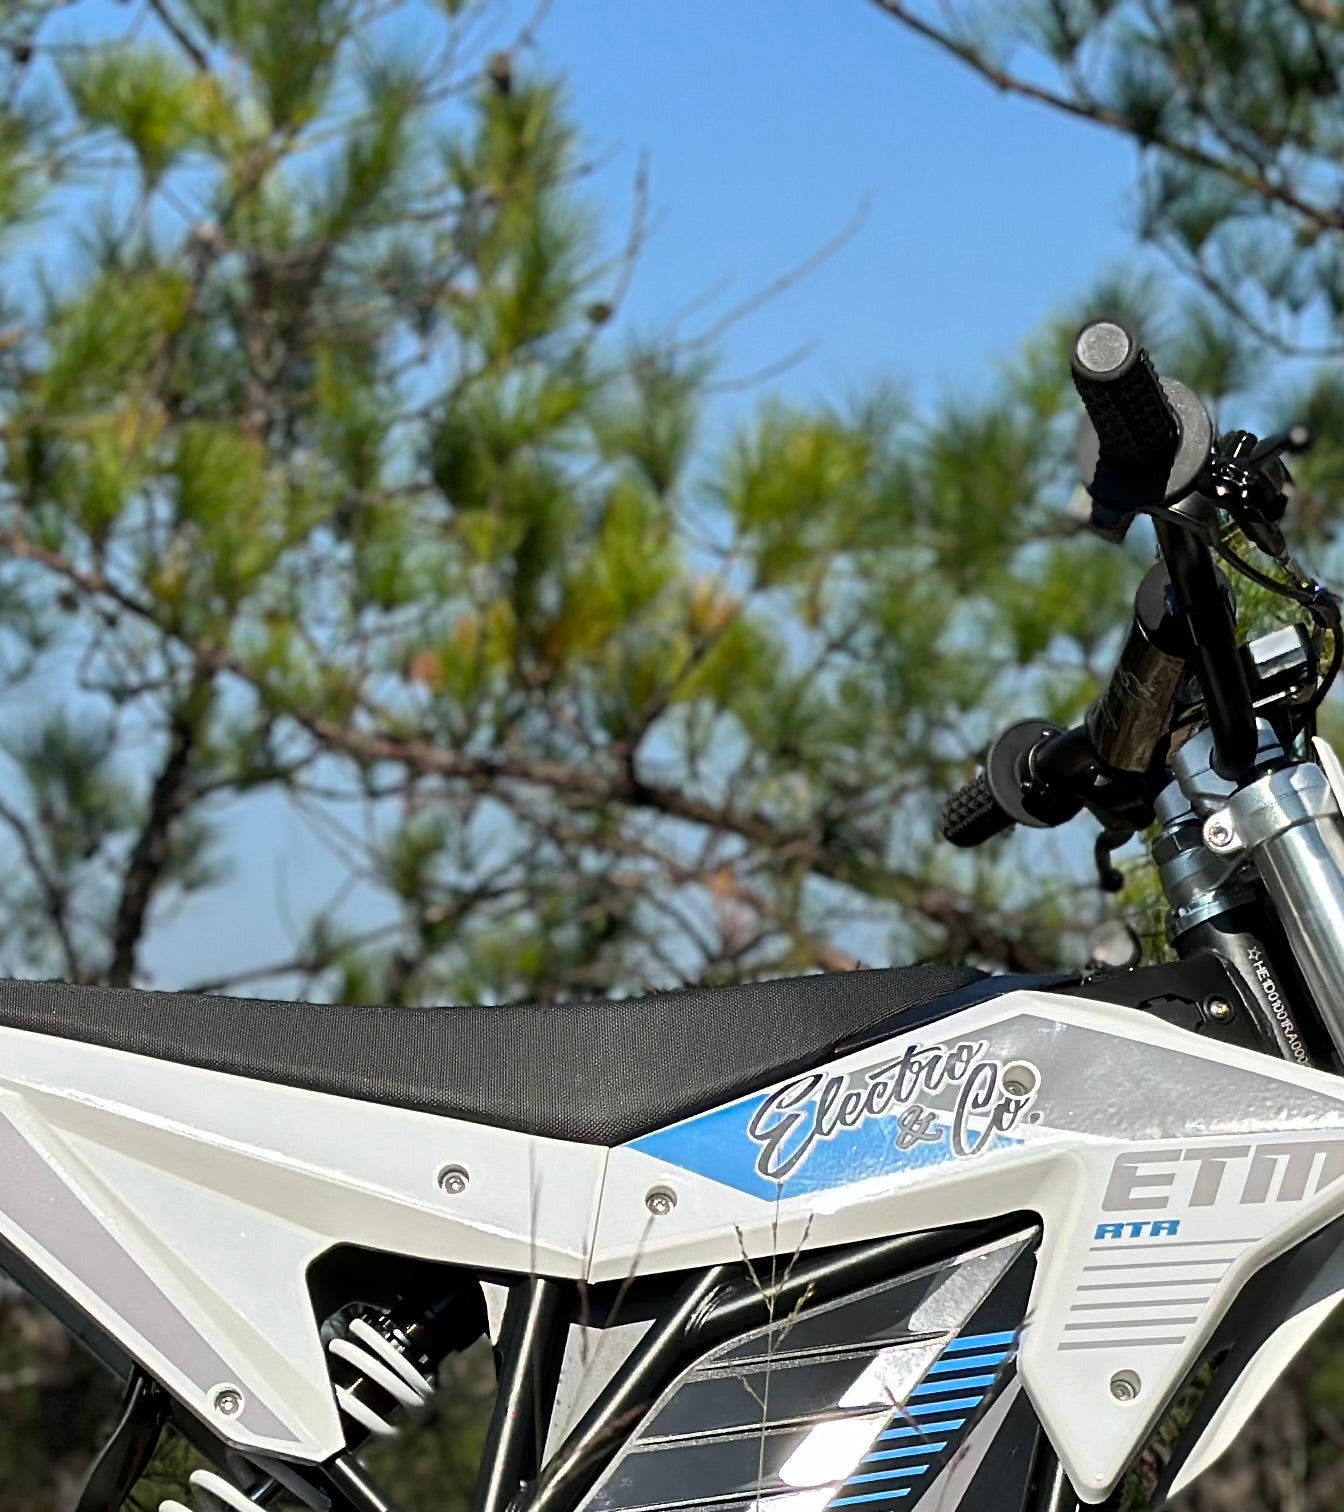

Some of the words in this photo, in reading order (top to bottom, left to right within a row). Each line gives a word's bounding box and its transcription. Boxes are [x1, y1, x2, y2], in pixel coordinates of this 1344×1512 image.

[748, 1042, 983, 1179] Electro
[896, 1104, 943, 1149] &
[952, 1062, 1041, 1157] Co.
[1093, 1219, 1181, 1240] RTR
